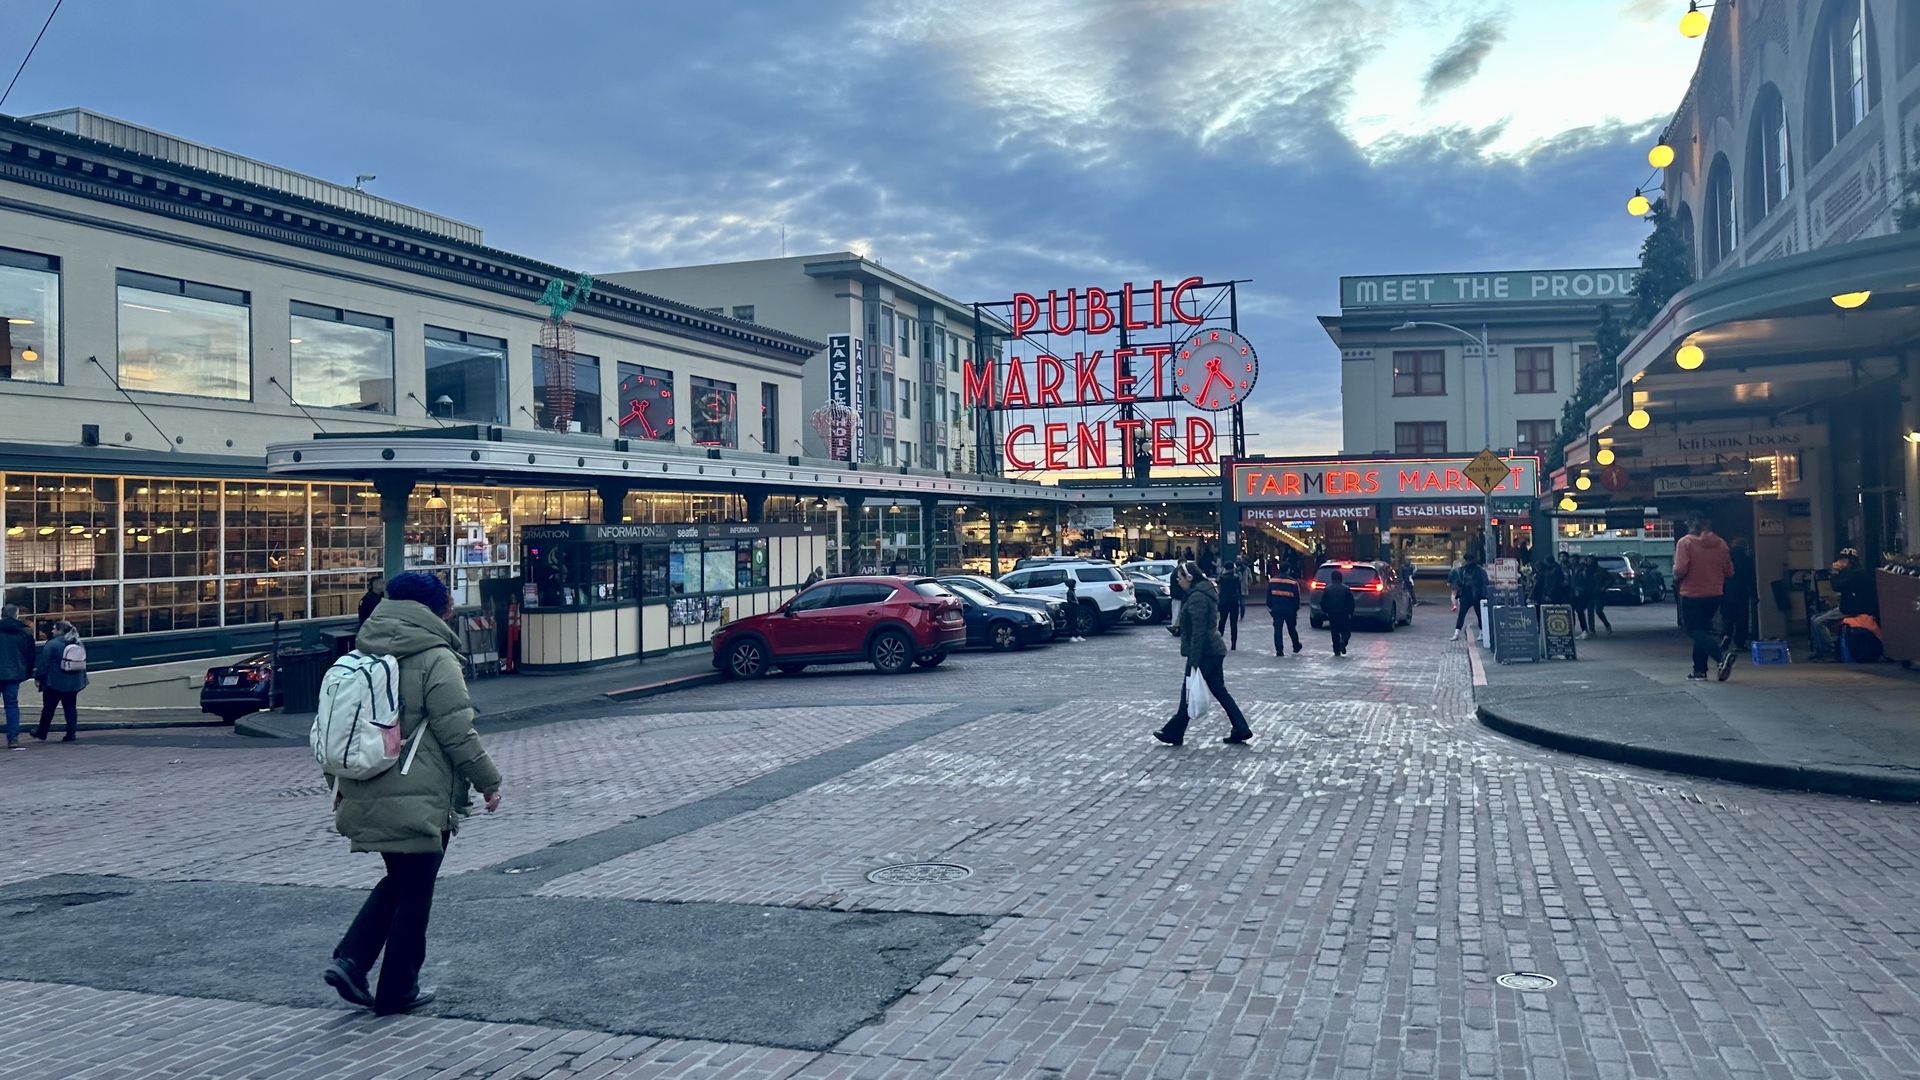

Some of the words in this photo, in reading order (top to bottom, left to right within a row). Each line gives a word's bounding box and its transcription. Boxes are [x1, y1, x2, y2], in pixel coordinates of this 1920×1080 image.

[1356, 279, 1435, 302] MEET
[1453, 276, 1510, 299] THE
[1531, 273, 1636, 298] PRODU
[1013, 277, 1204, 339] PUBLIC
[1193, 338, 1201, 346] 11
[1209, 331, 1220, 341] 12
[832, 339, 846, 358] LA
[856, 340, 862, 360] LA
[1181, 350, 1190, 359] 10
[1241, 346, 1248, 355] 2
[1177, 367, 1184, 376] 9
[1246, 363, 1252, 372] 3
[832, 361, 847, 407] SALL
[963, 346, 1175, 411] MARKET
[1182, 384, 1189, 392] 8
[1241, 381, 1248, 389] 4
[1230, 393, 1237, 402] 5
[835, 416, 848, 461] HOTE
[1005, 416, 1215, 471] CENTER
[1702, 436, 1743, 448] bank
[1748, 433, 1800, 446] books
[1247, 471, 1380, 496] FARMERS
[1399, 467, 1524, 492] MART
[1659, 479, 1678, 490] The
[1247, 509, 1274, 520] PIKE
[1278, 508, 1317, 519] PLACE
[1321, 506, 1370, 518] MARKET
[1397, 505, 1477, 517] ESTABLISHED
[522, 529, 570, 539] ORMATION
[597, 526, 655, 538] INFORMATION
[677, 526, 699, 538] seattle
[729, 526, 759, 534] INFORMATION
[860, 566, 891, 575] ARET
